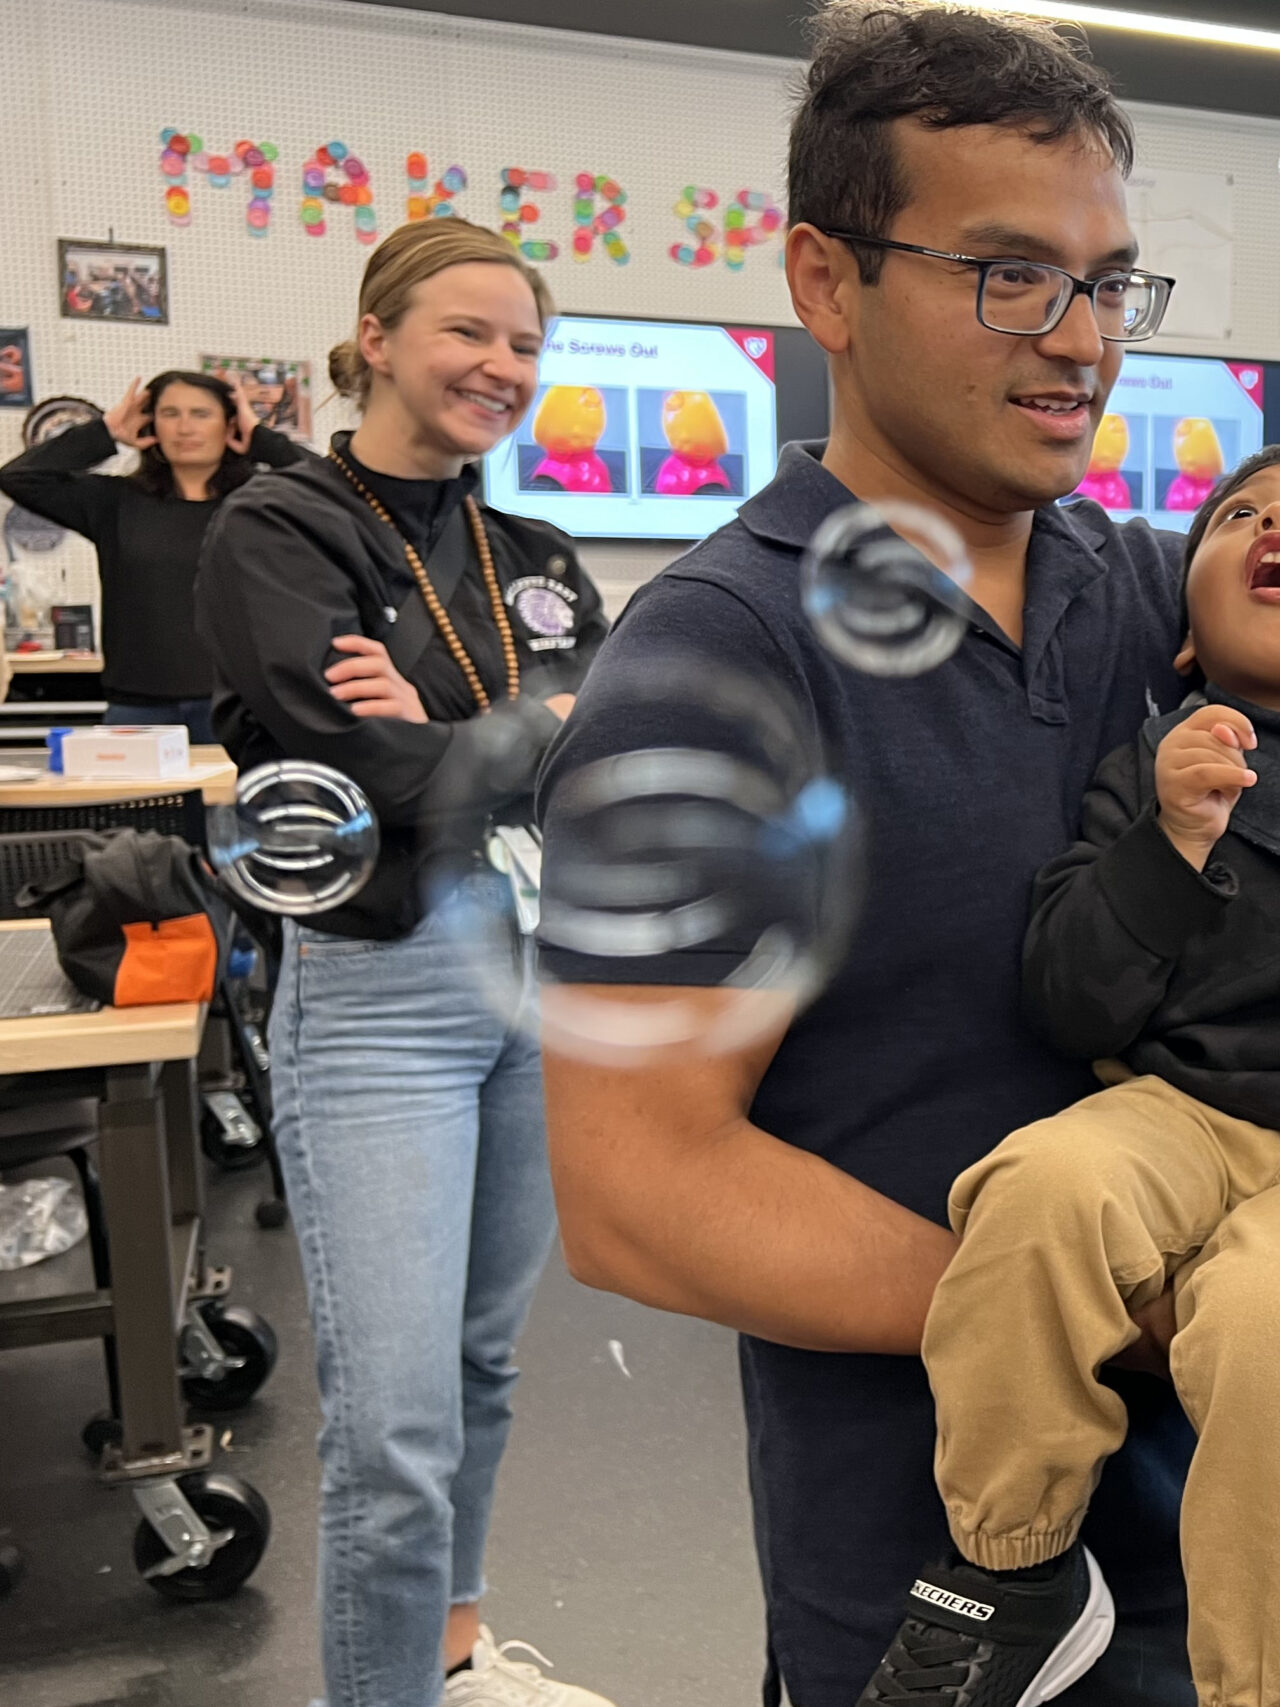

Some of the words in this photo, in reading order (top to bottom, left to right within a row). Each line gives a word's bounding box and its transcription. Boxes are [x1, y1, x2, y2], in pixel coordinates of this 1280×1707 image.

[160, 127, 630, 266] MAKER
[668, 187, 788, 272] SP
[568, 338, 626, 357] Screws
[630, 341, 659, 358] Out
[911, 1582, 992, 1618] KECHERS
